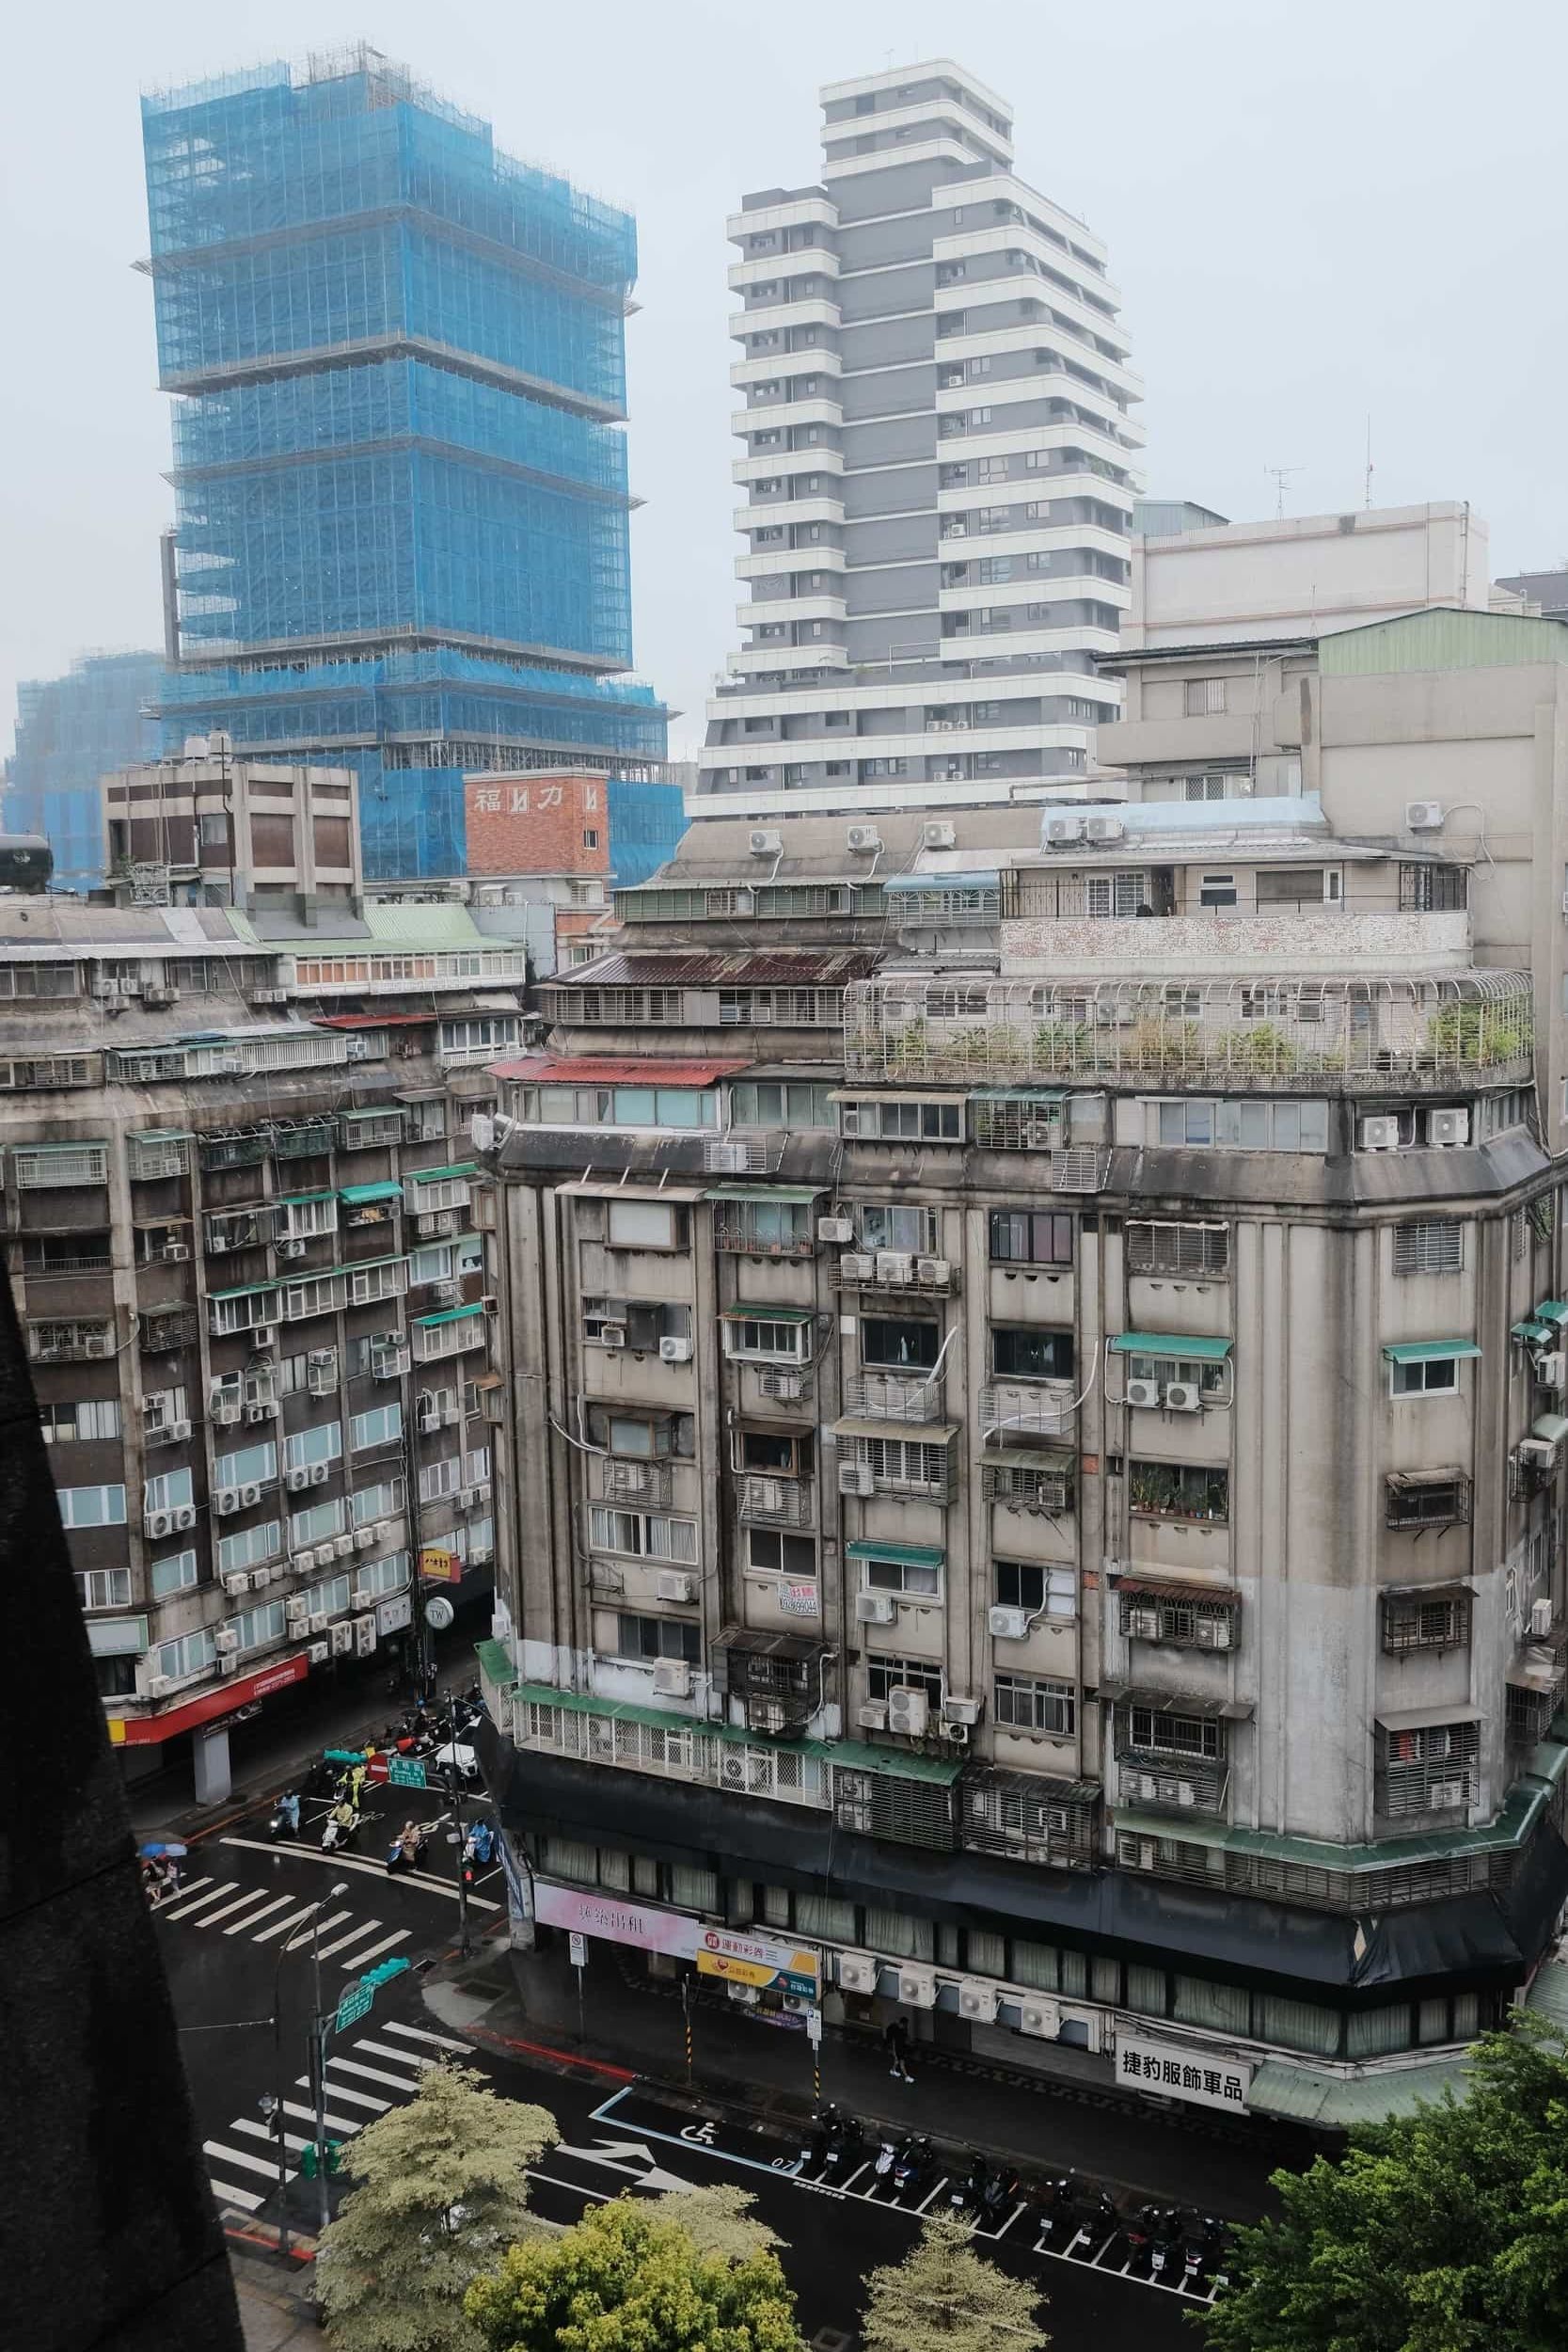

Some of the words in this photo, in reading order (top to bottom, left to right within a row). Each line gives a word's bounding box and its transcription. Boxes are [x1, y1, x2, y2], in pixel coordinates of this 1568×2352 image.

[1122, 2050, 1243, 2102] 捷豹服飾軍品
[771, 2157, 796, 2170] 07
